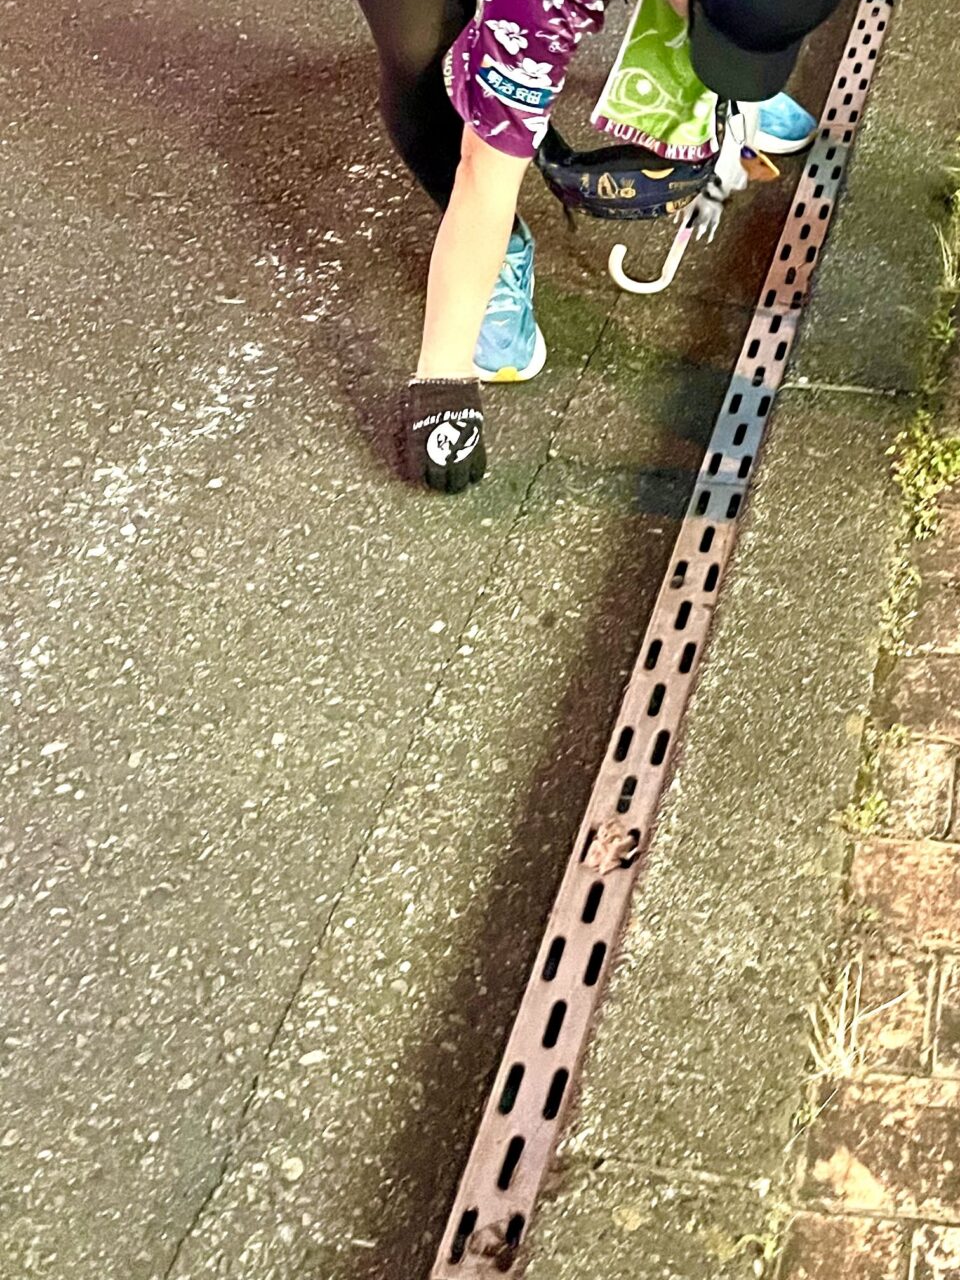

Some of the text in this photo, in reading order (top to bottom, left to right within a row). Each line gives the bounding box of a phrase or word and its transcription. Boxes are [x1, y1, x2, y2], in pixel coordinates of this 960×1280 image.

[487, 70, 543, 105] 明治安田
[664, 143, 706, 160] MYFC
